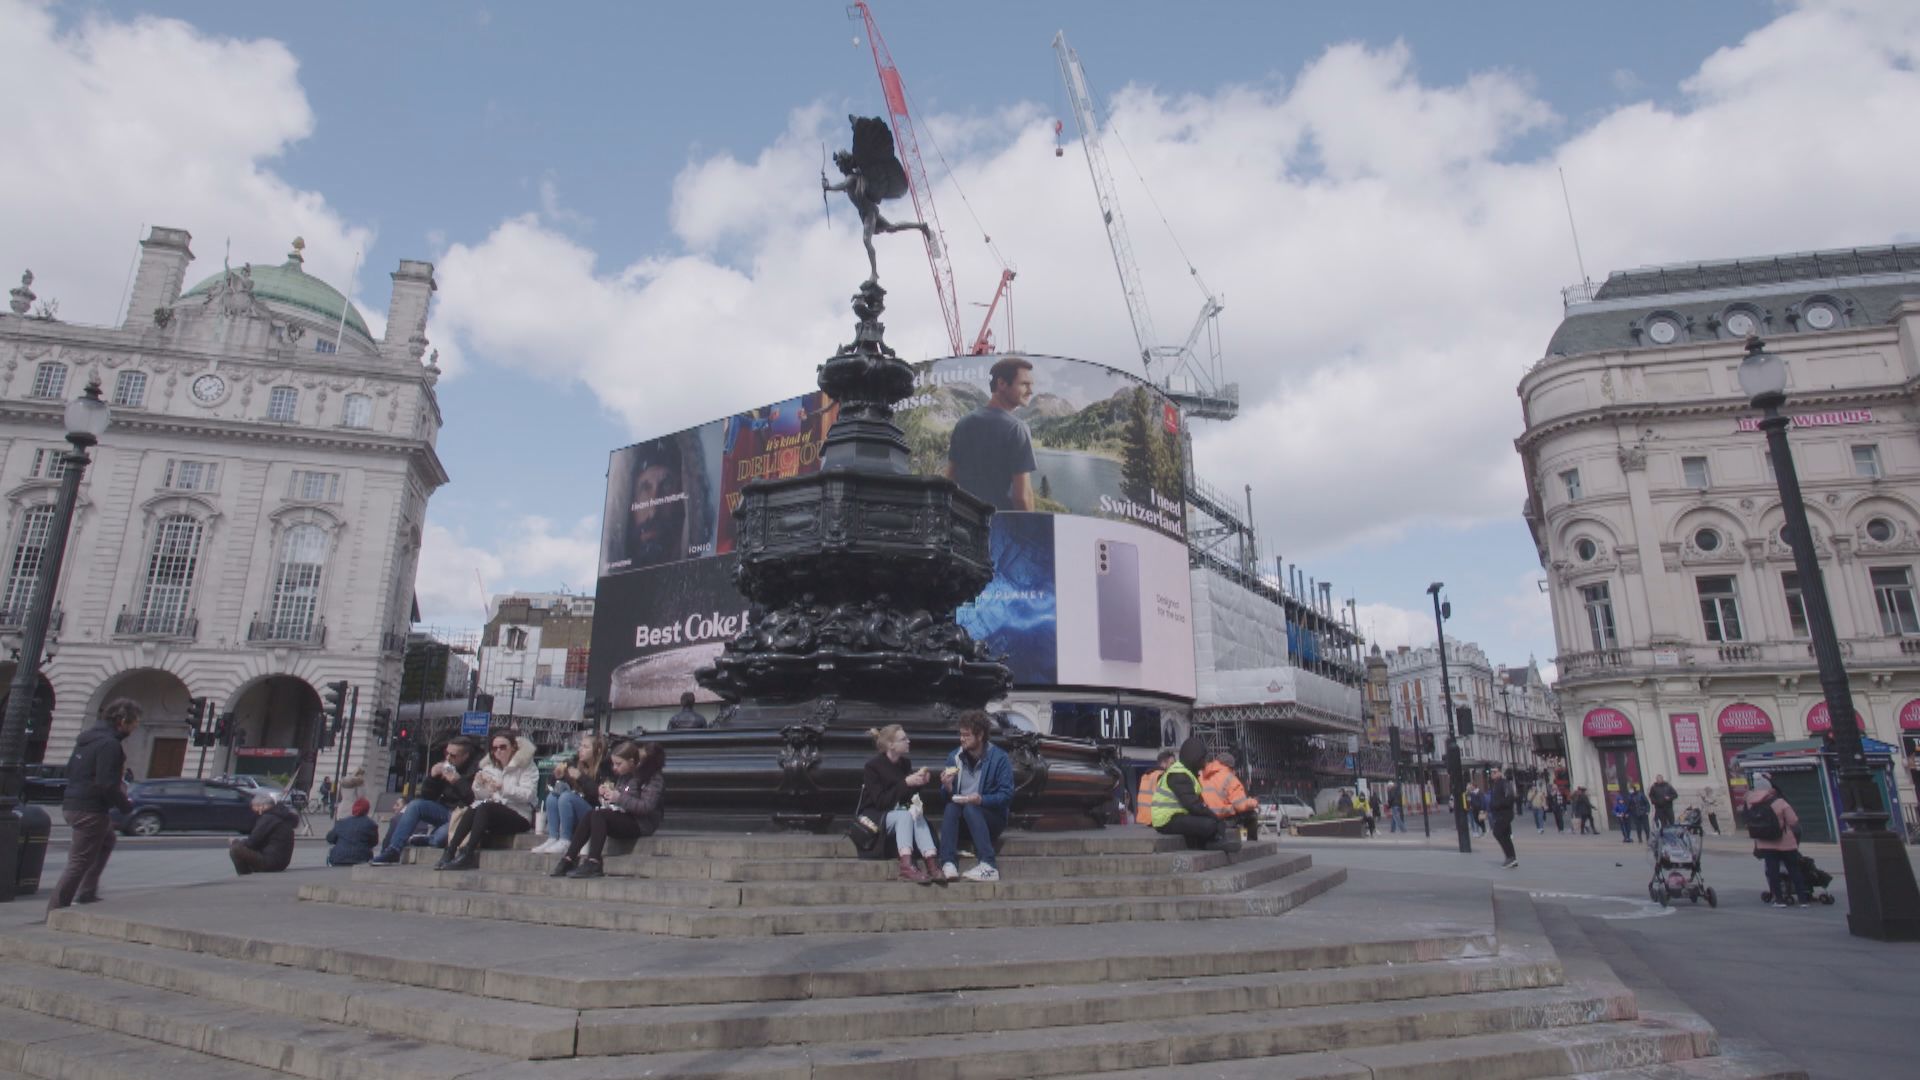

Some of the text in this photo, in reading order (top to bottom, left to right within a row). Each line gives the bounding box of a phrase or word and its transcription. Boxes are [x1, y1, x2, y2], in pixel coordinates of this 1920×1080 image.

[1793, 408, 1873, 428] WORLDS
[780, 432, 802, 447] kind
[802, 428, 813, 442] of
[736, 440, 825, 482] DELICIOU
[1100, 494, 1184, 537] Switzerland.
[1151, 488, 1181, 517] I need
[995, 590, 1045, 600] PLANET
[636, 620, 683, 648] Best
[685, 612, 738, 641] Coke
[1100, 708, 1132, 739] GAP
